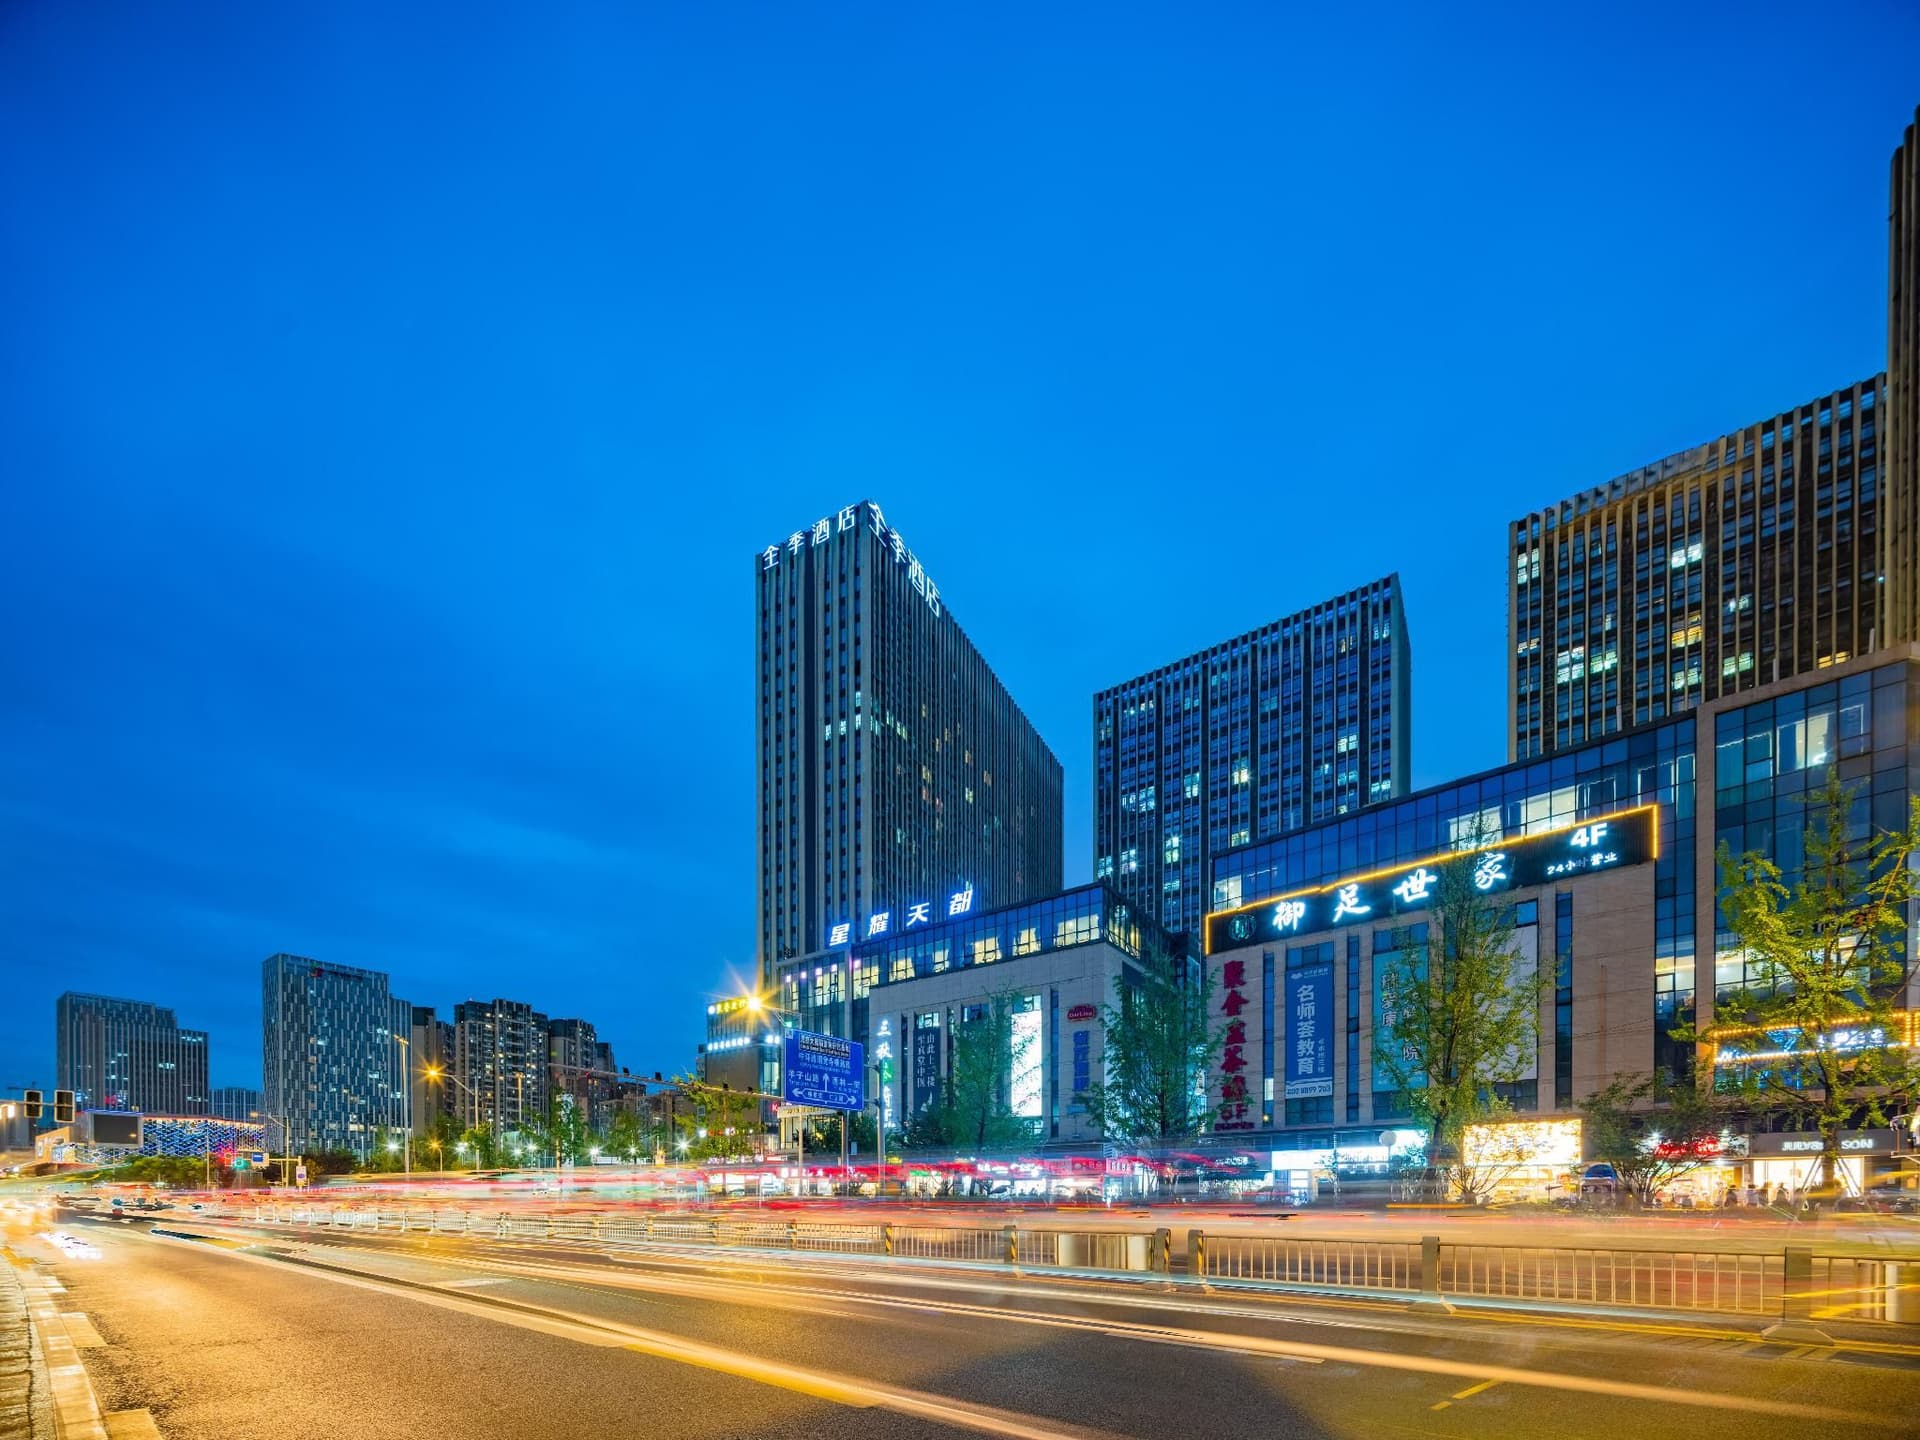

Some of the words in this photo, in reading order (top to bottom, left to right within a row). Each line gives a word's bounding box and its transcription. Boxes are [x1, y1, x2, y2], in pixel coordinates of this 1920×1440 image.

[763, 503, 856, 571] 全季酒店
[1570, 822, 1608, 847] 4F
[829, 889, 974, 947] 星耀天都
[1272, 852, 1507, 931] 御足世家
[1296, 984, 1316, 1076] 名师荟教育
